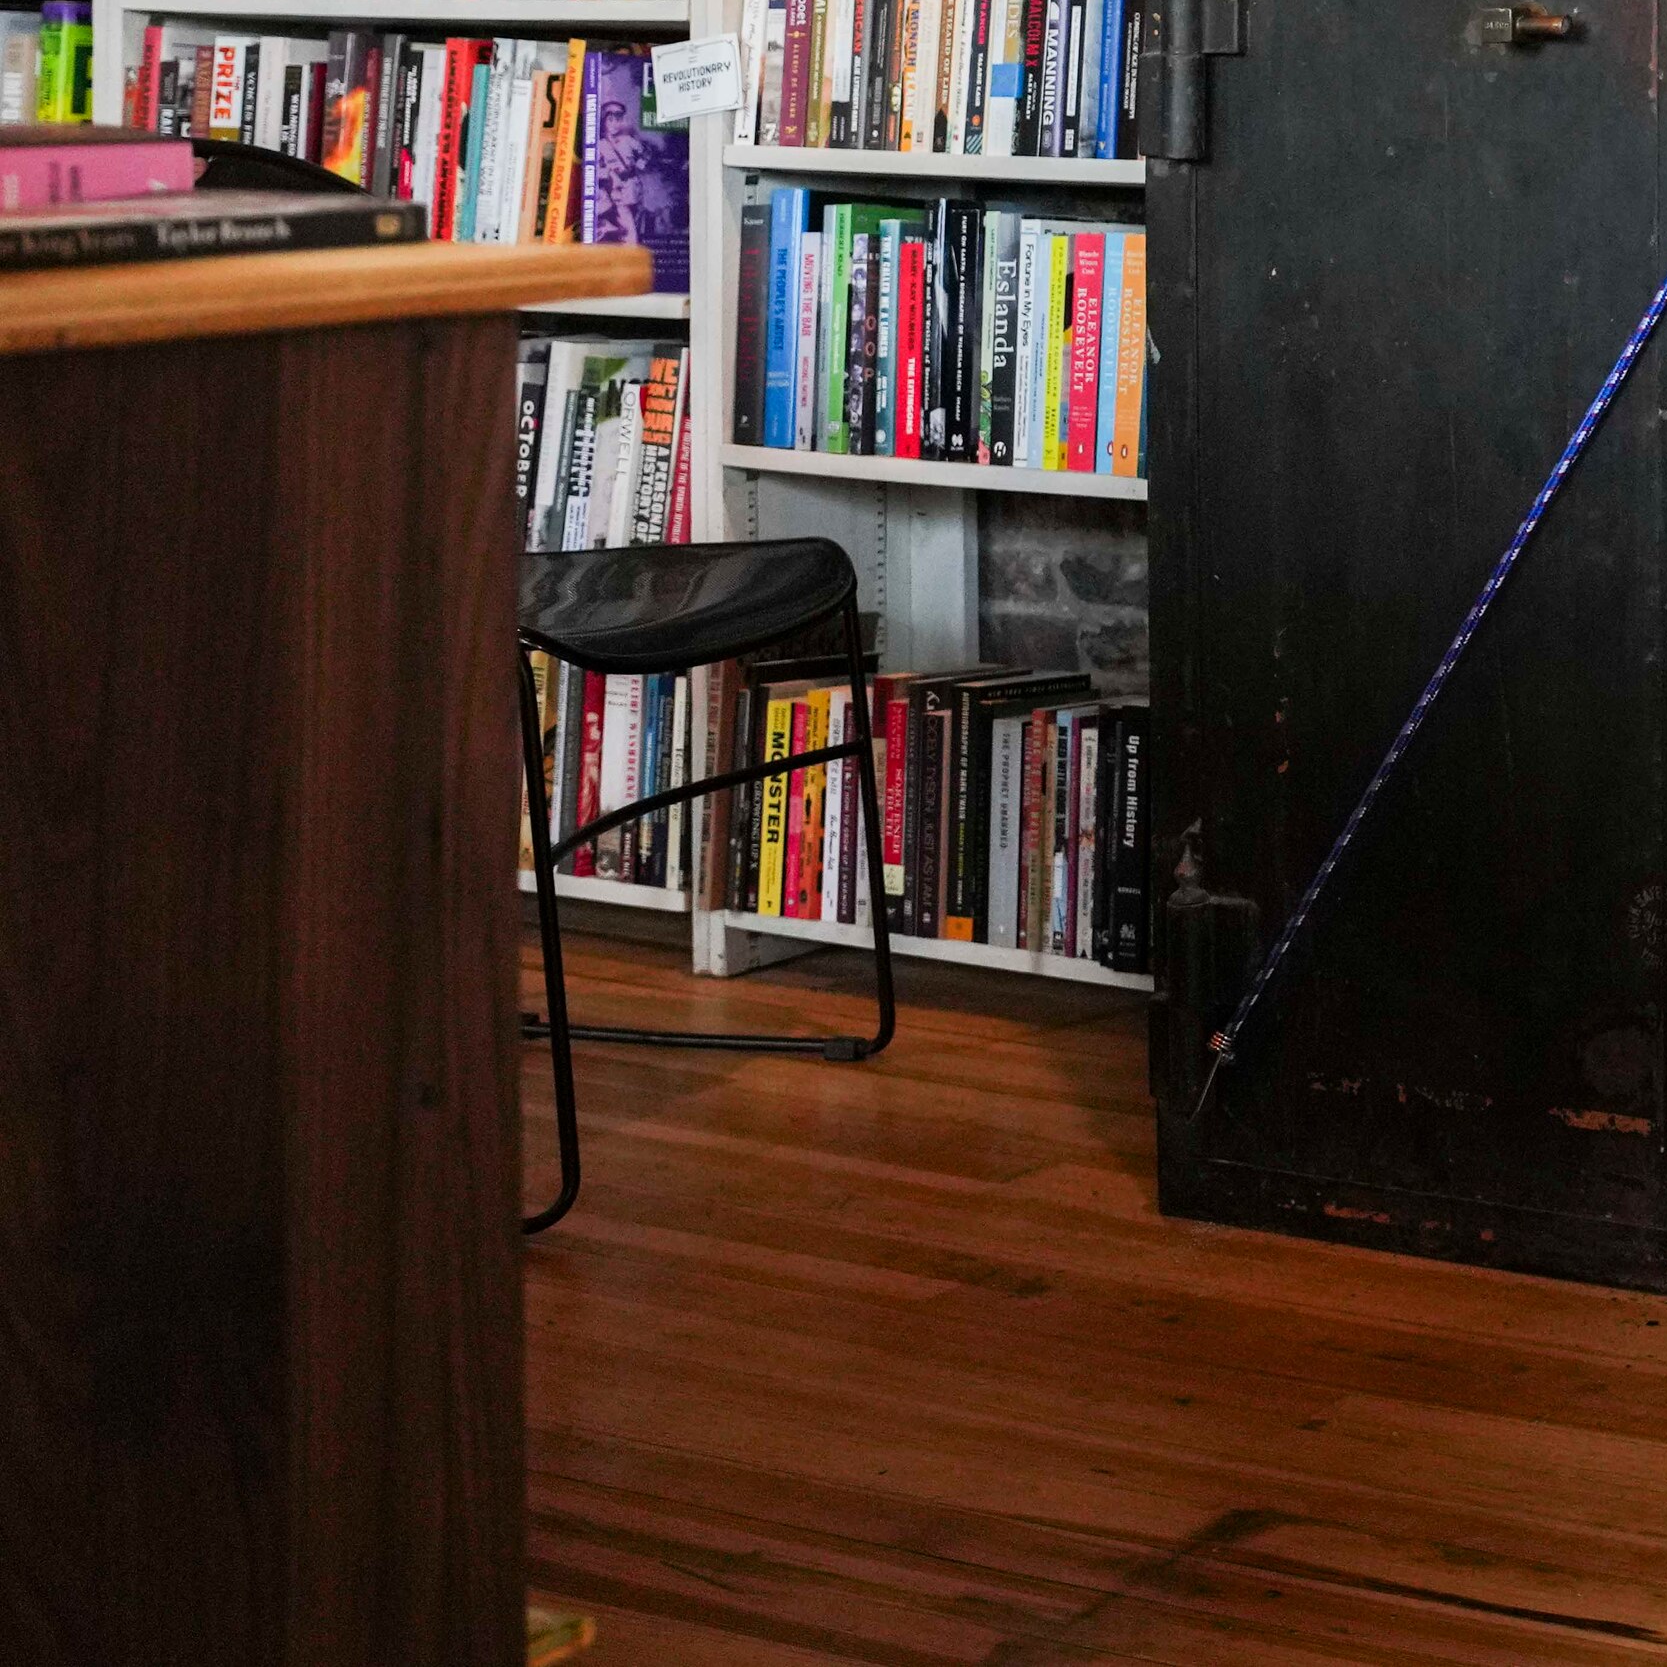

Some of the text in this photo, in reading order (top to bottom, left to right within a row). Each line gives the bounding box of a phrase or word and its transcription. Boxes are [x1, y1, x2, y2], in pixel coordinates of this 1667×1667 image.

[214, 47, 235, 120] PRIZE
[663, 63, 731, 85] REVOLUTIONARY
[678, 77, 712, 92] HISTORY
[1043, 29, 1059, 125] MANNING
[993, 260, 1017, 369] Eslanda
[1073, 287, 1087, 392] ROOSEVELT
[1084, 297, 1098, 383] ELEANOR
[516, 400, 536, 498] OCTOBER
[615, 391, 637, 477] ORWELL
[1123, 735, 1140, 848] Up from History
